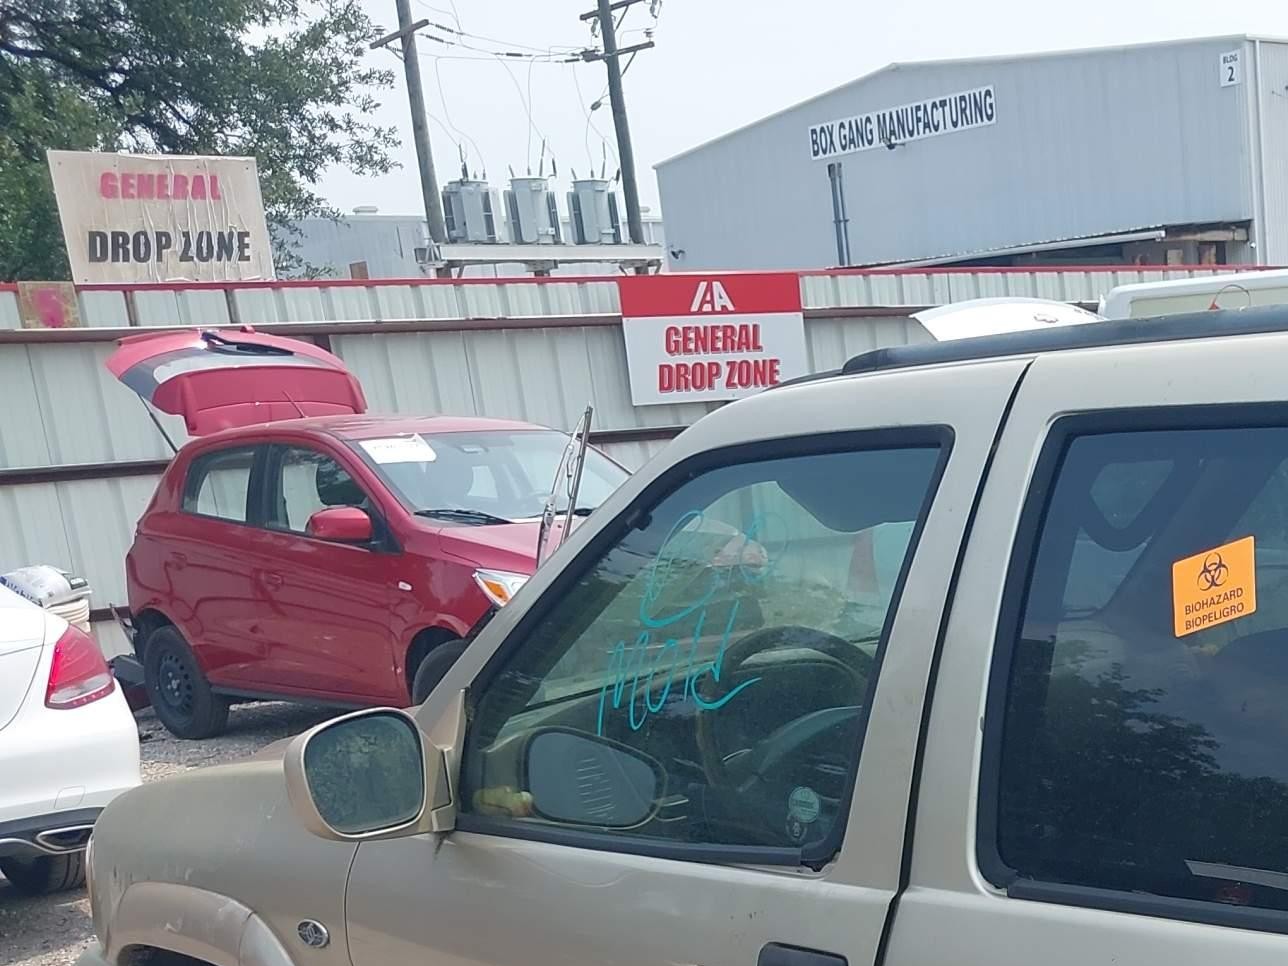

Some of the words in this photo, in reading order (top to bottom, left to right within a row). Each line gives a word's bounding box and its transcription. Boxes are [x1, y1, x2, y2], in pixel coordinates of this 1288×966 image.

[1227, 66, 1235, 82] 2
[810, 124, 837, 157] BOX
[838, 116, 874, 152] GANG
[876, 88, 995, 144] MANUFACTURING
[100, 172, 222, 200] GENERAL
[88, 230, 172, 264] DROP
[179, 231, 251, 263] ZONE
[665, 324, 763, 356] GENERAL
[658, 361, 721, 394] DROP
[725, 359, 780, 389] ZONE
[1185, 587, 1244, 615] BIOHAZARD
[1185, 603, 1245, 630] BIOPELIGRO
